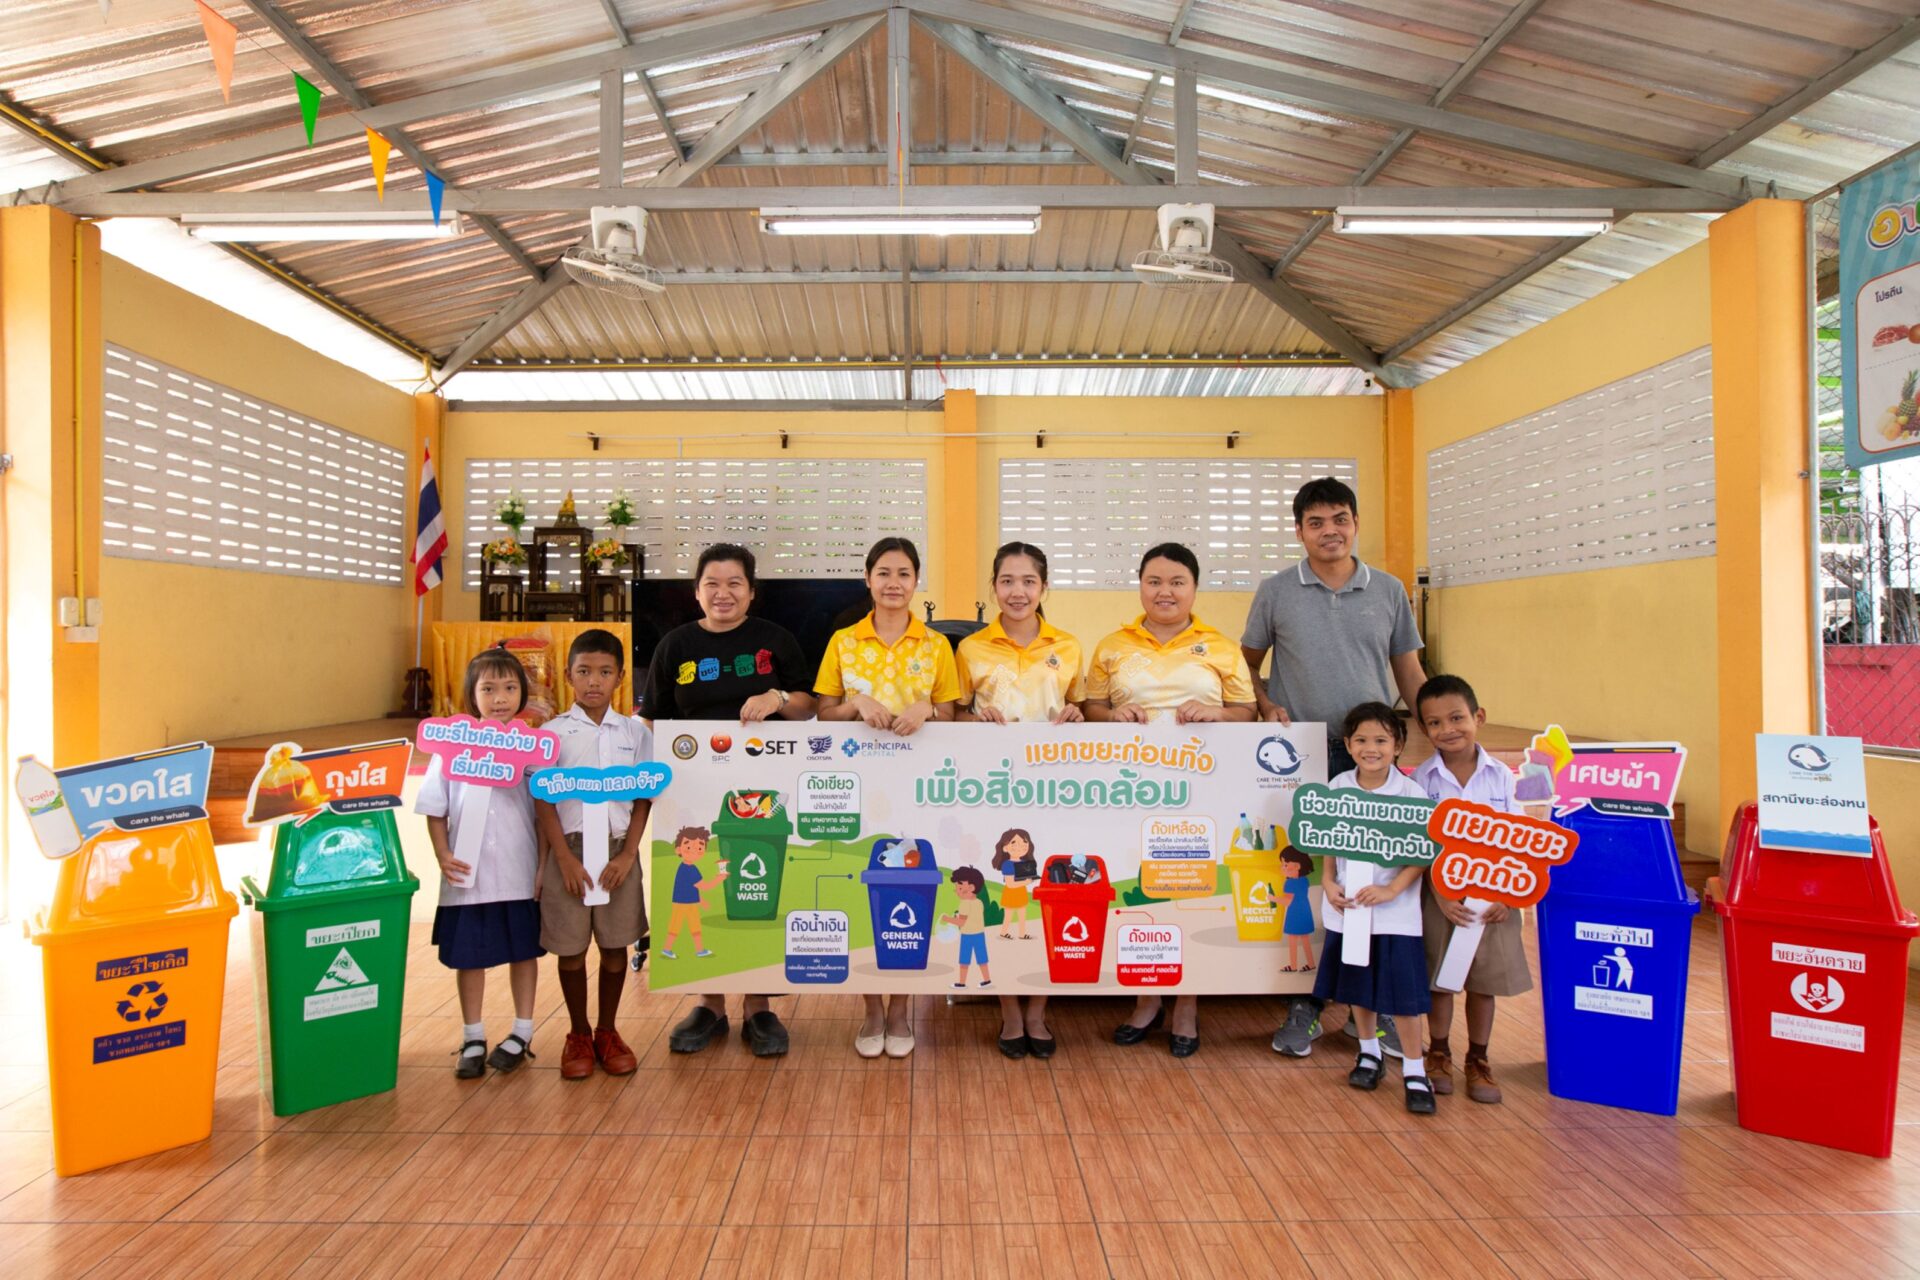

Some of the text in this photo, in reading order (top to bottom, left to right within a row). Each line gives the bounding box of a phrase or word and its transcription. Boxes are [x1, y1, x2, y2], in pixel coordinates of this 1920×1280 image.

[1875, 286, 1903, 303] โปรตีน
[424, 722, 535, 751] ขยะรีไซเคิลง่าย
[861, 739, 913, 751] PRINCIPAL
[765, 740, 798, 755] SET
[1024, 736, 1213, 773] แยกขยะก่อนทิ้ง
[451, 750, 513, 779] เริ่มที่เรา
[325, 761, 388, 797] ถุงใส
[807, 775, 854, 790] ถังเขียว
[915, 757, 1189, 806] เพื่อสิ่งแวดล้อม
[1569, 762, 1661, 791] เศษผ้า
[81, 768, 193, 808] ขวดใส
[1301, 791, 1434, 821] ช่วยกันแยกขย
[1619, 802, 1631, 810] the
[1632, 804, 1654, 813] whale
[1762, 793, 1866, 809] สถานีขยะล่องหน
[166, 811, 190, 820] whale
[1151, 820, 1207, 835] ถังเหลือง
[1447, 812, 1563, 856] แยกขยะ
[1300, 822, 1432, 859] โลกยิ้มได้ทุกวัน
[1446, 857, 1532, 892] ถูกถัง
[739, 883, 767, 891] FOOD
[737, 892, 769, 901] WASTE
[1242, 907, 1276, 915] RECYCLE
[1245, 915, 1274, 924] WASTE
[791, 913, 847, 932] ถังน้ำเงิน
[311, 925, 376, 945] ขยะเปียก
[881, 931, 924, 940] GENERAL
[1129, 928, 1172, 943] ถังแดง
[1579, 926, 1649, 945] ขยะทั่วไป
[886, 941, 919, 950] WASTE
[1054, 945, 1095, 953] HAZARDOUS
[99, 953, 186, 979] ขยะรีไซเคิล
[1775, 948, 1862, 971] ขยะอันตราย
